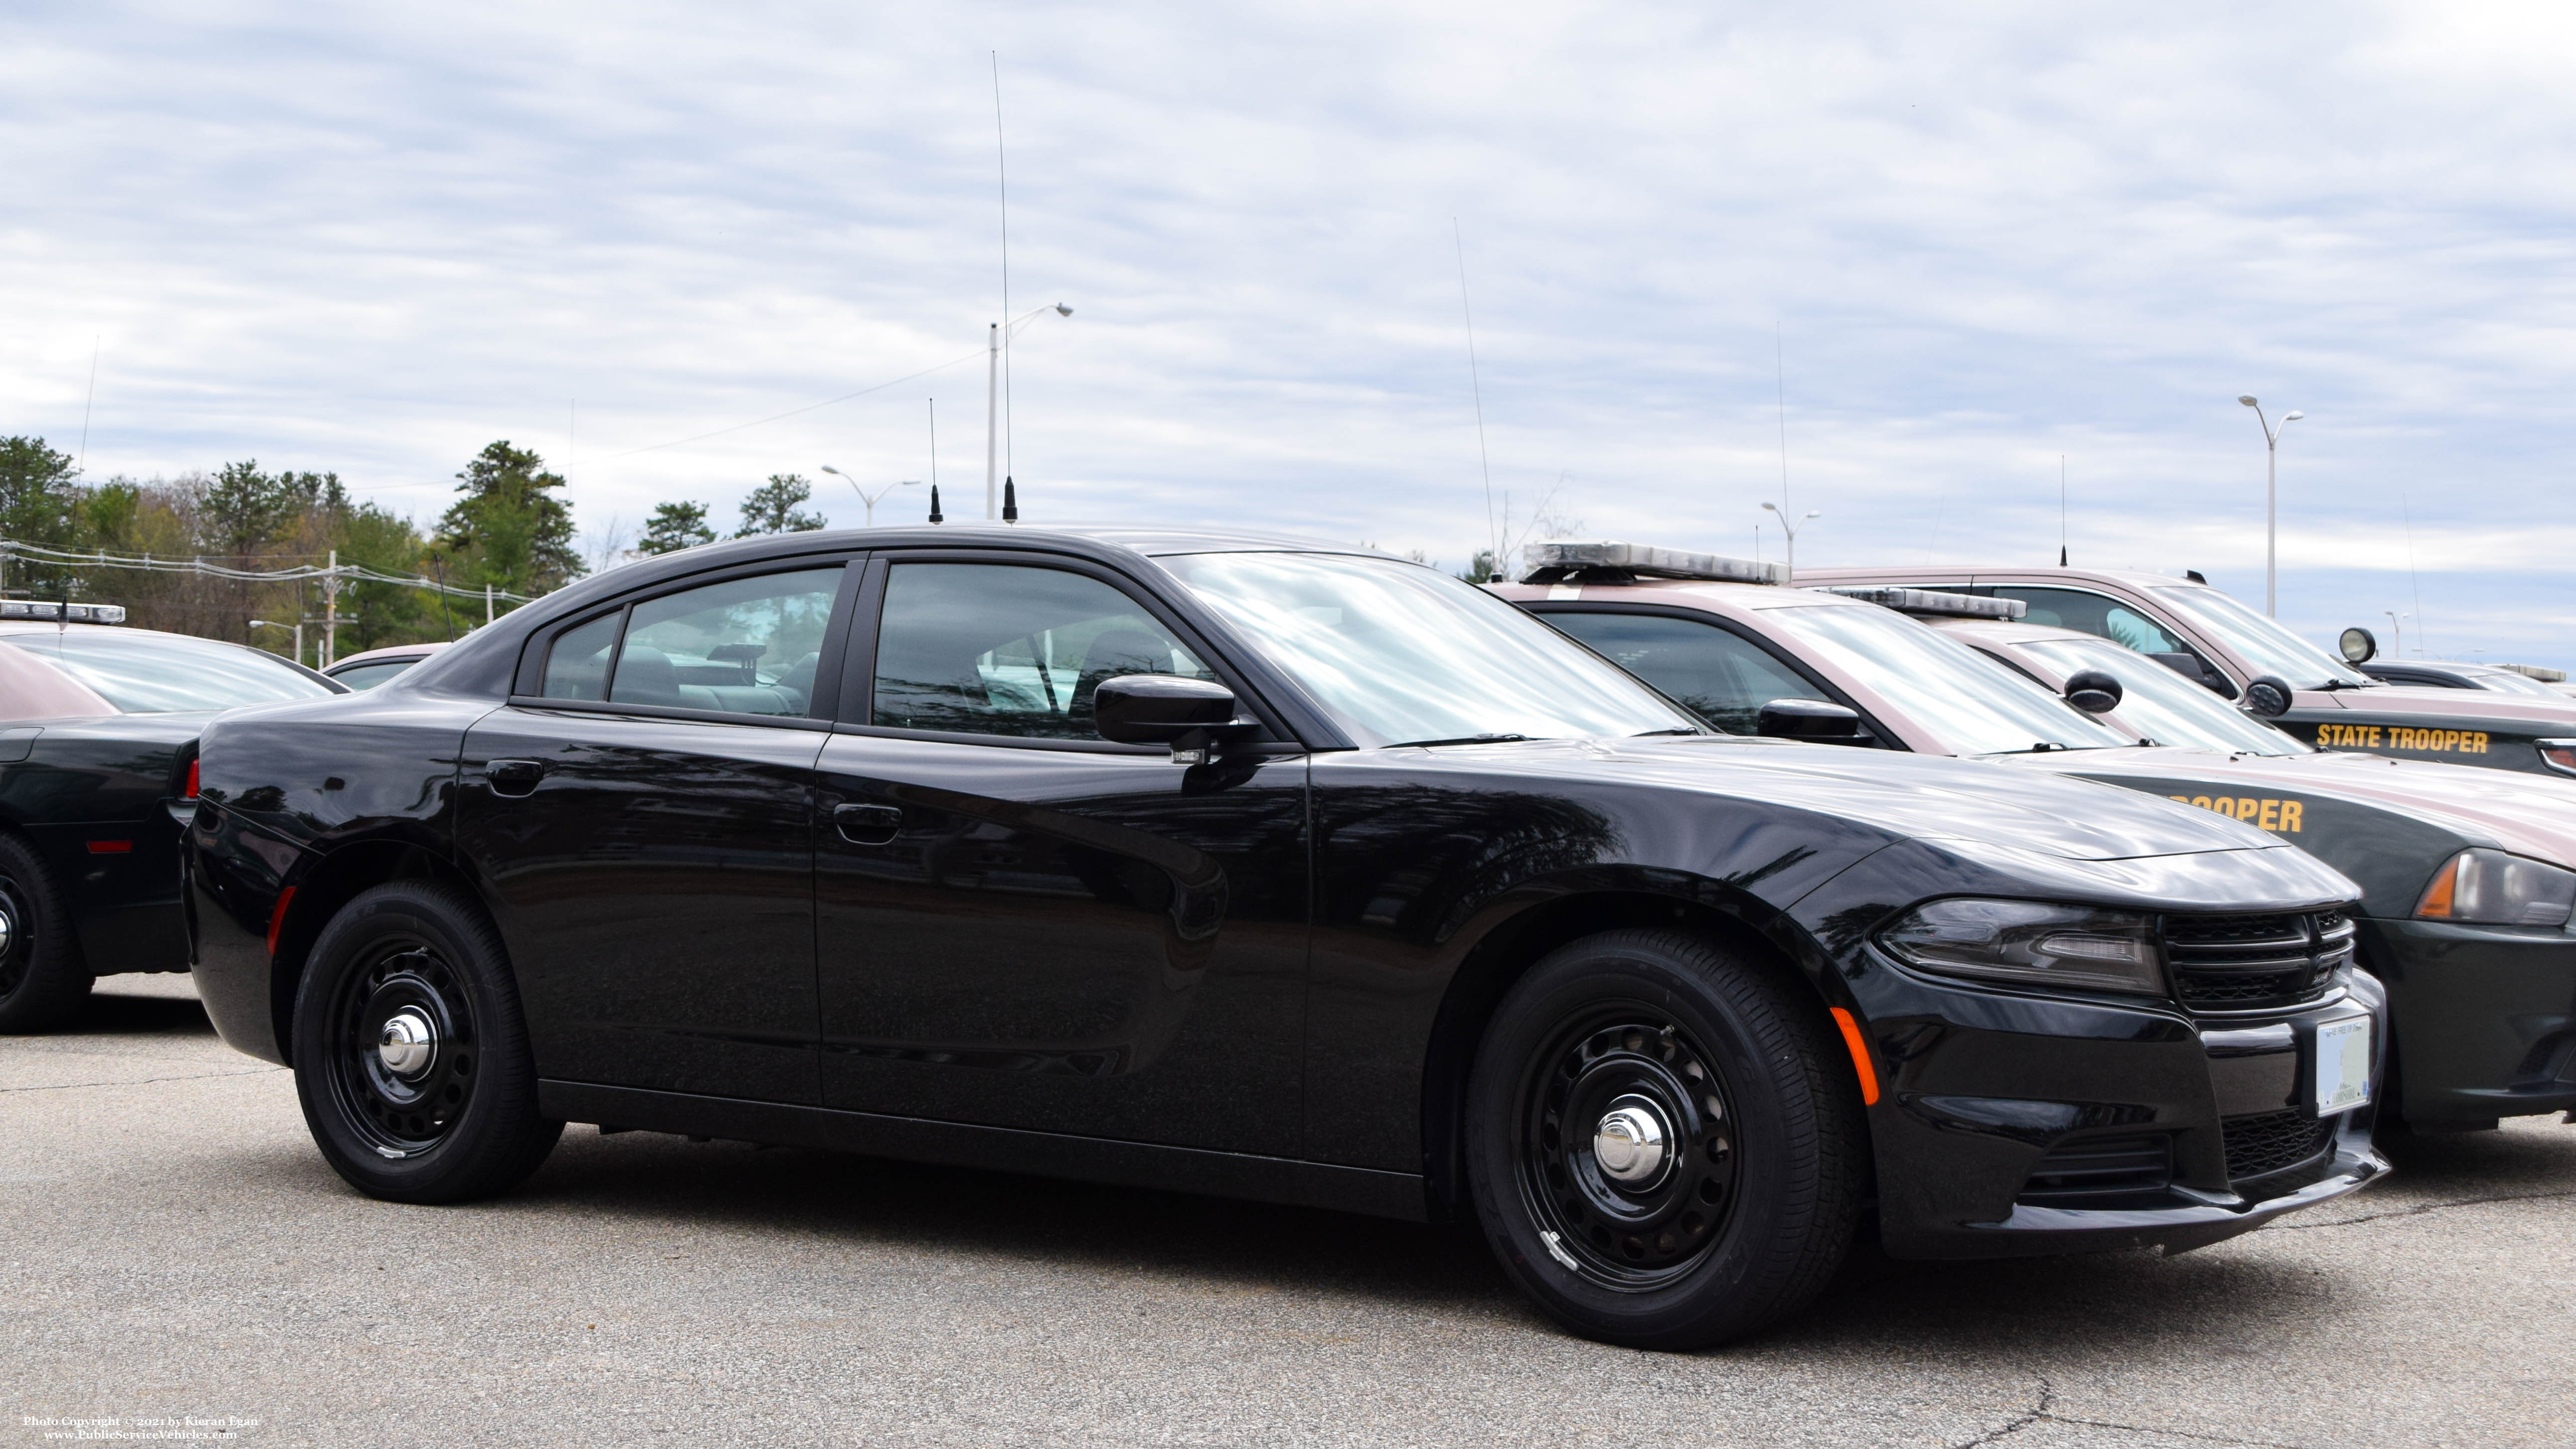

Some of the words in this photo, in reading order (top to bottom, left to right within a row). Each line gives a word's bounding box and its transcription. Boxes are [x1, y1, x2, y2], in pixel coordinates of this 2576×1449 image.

[2317, 724, 2381, 747] STATE
[2389, 728, 2487, 753] TROOPER
[2169, 796, 2302, 832] OPER
